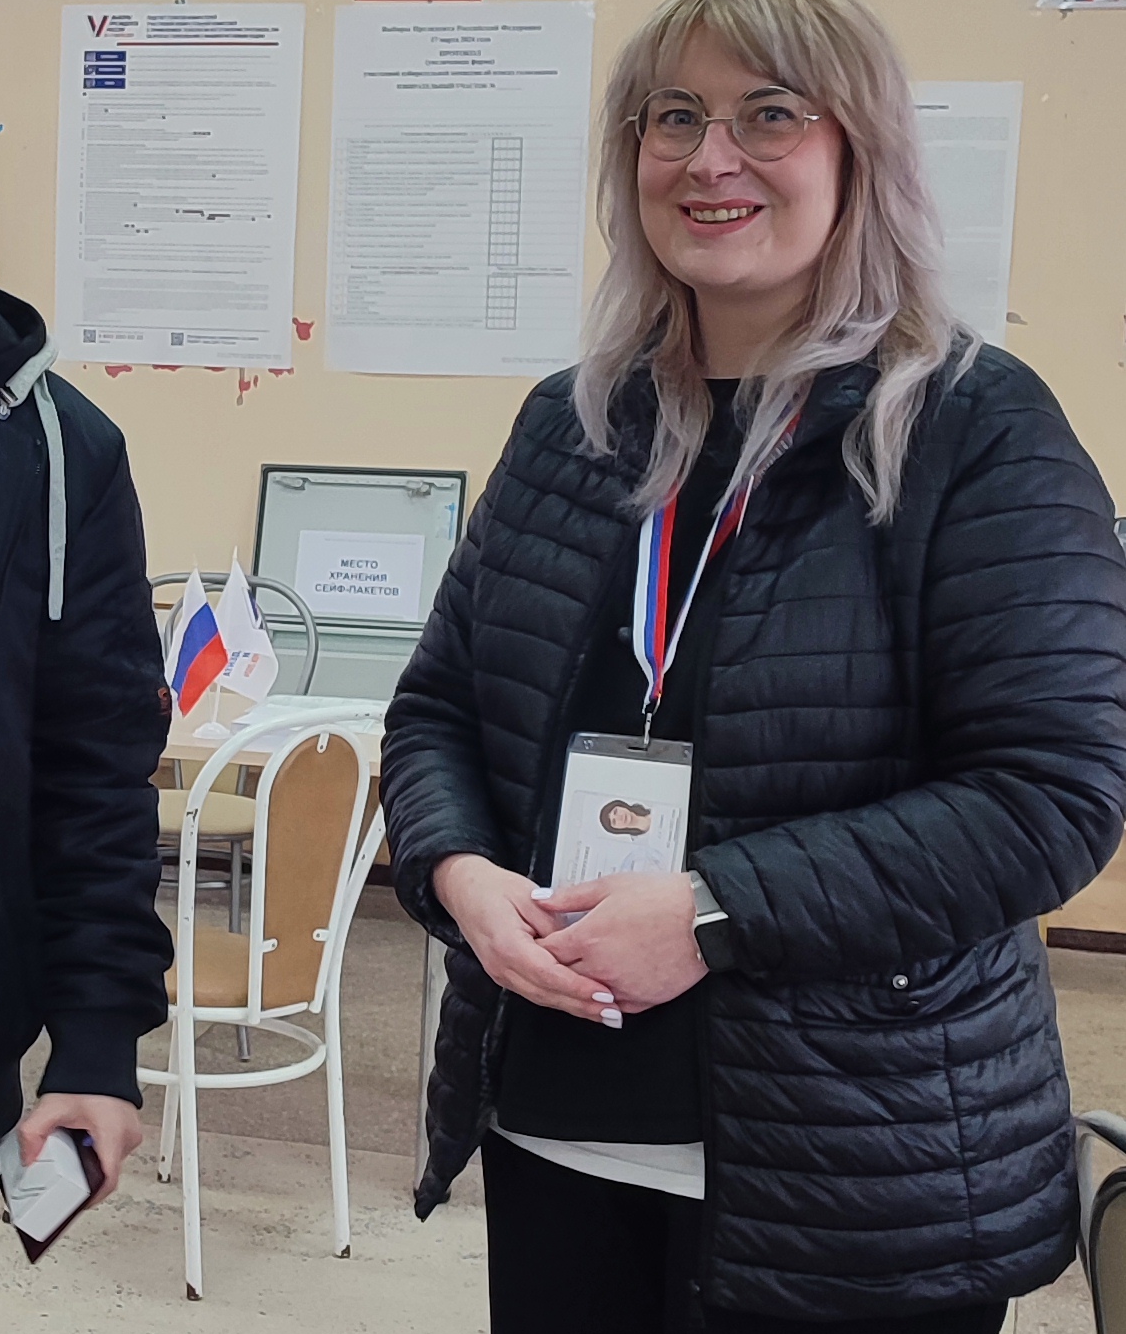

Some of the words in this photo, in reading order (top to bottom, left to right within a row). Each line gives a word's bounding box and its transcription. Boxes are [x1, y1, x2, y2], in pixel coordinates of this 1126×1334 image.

[340, 559, 378, 569] МЕСТО
[329, 571, 387, 582] ХРАНЕНИЯ
[315, 583, 400, 596] СЕЙФ-ПАКЕТОВ
